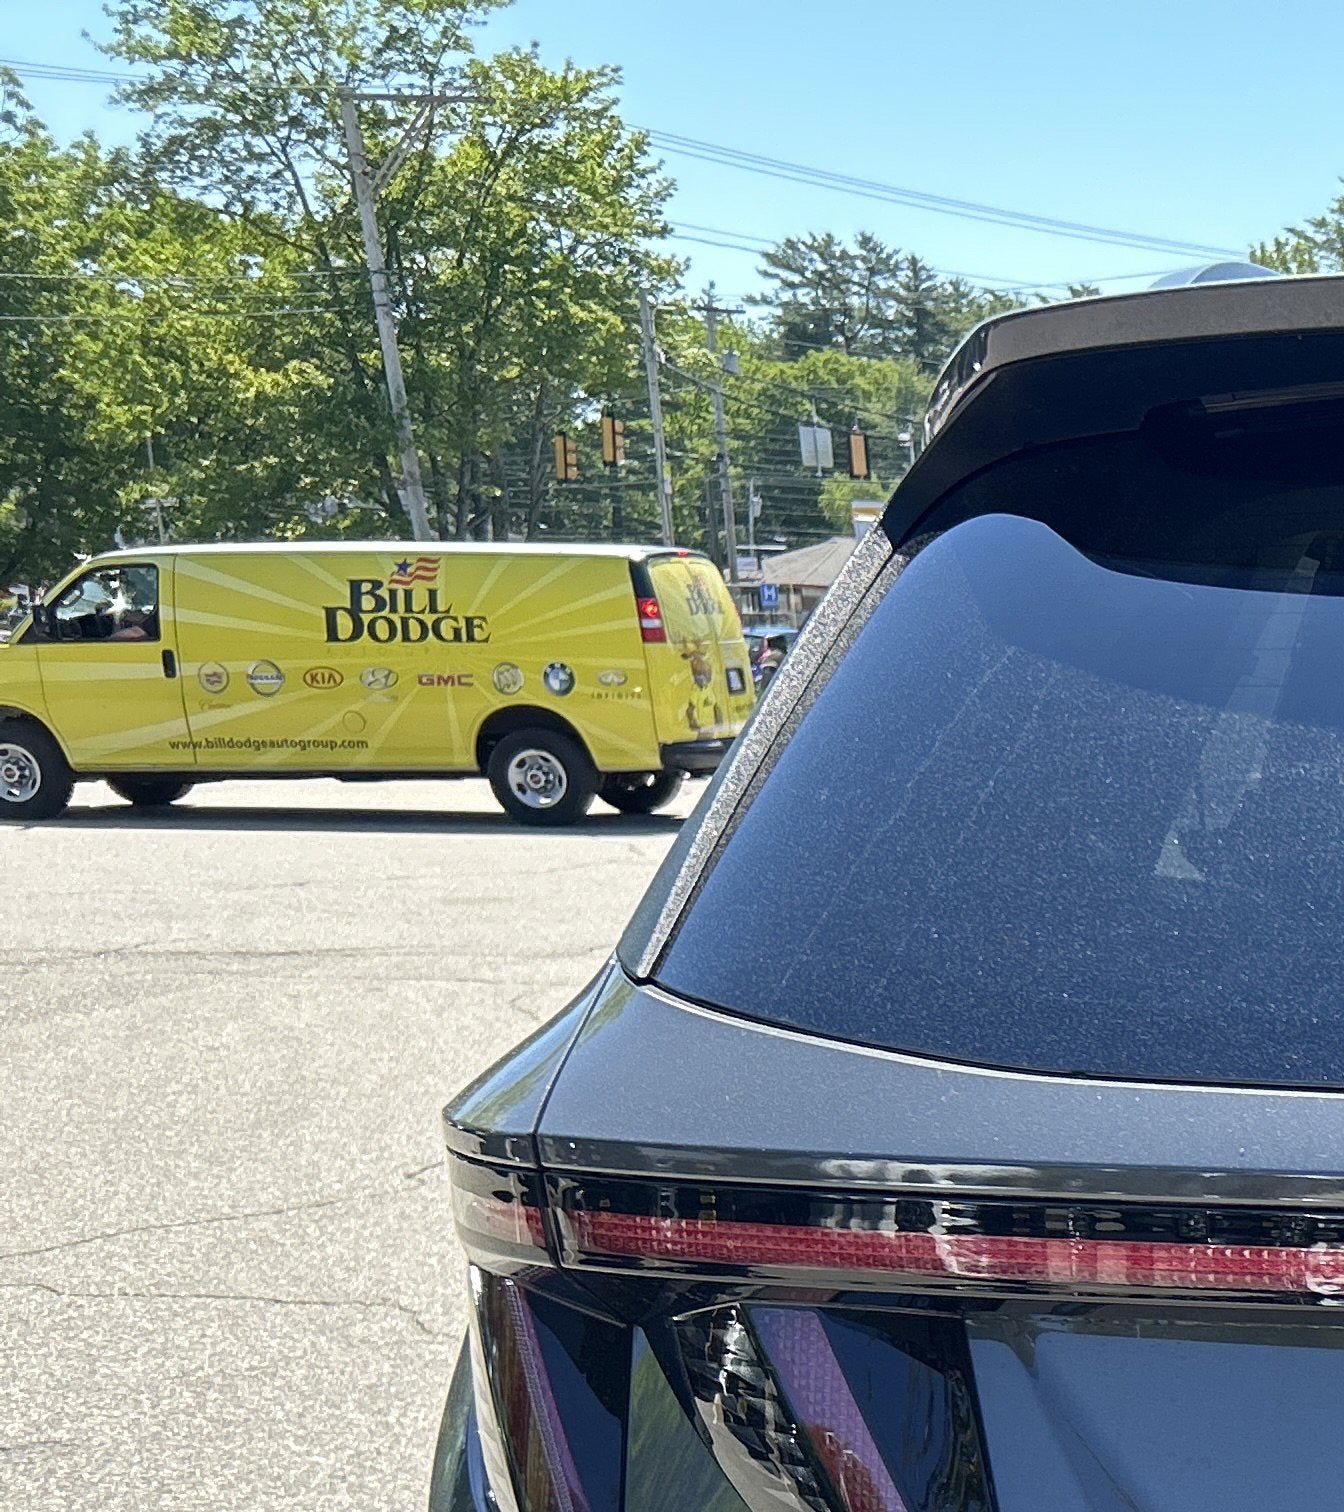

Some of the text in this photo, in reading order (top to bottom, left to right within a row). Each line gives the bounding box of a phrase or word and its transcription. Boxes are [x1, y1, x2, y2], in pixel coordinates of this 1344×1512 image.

[346, 579, 453, 614] BILL
[323, 605, 491, 643] DODGE
[309, 671, 337, 685] KIA
[417, 673, 474, 687] GMC
[168, 736, 369, 751] www.billdodgeautogroup.com
